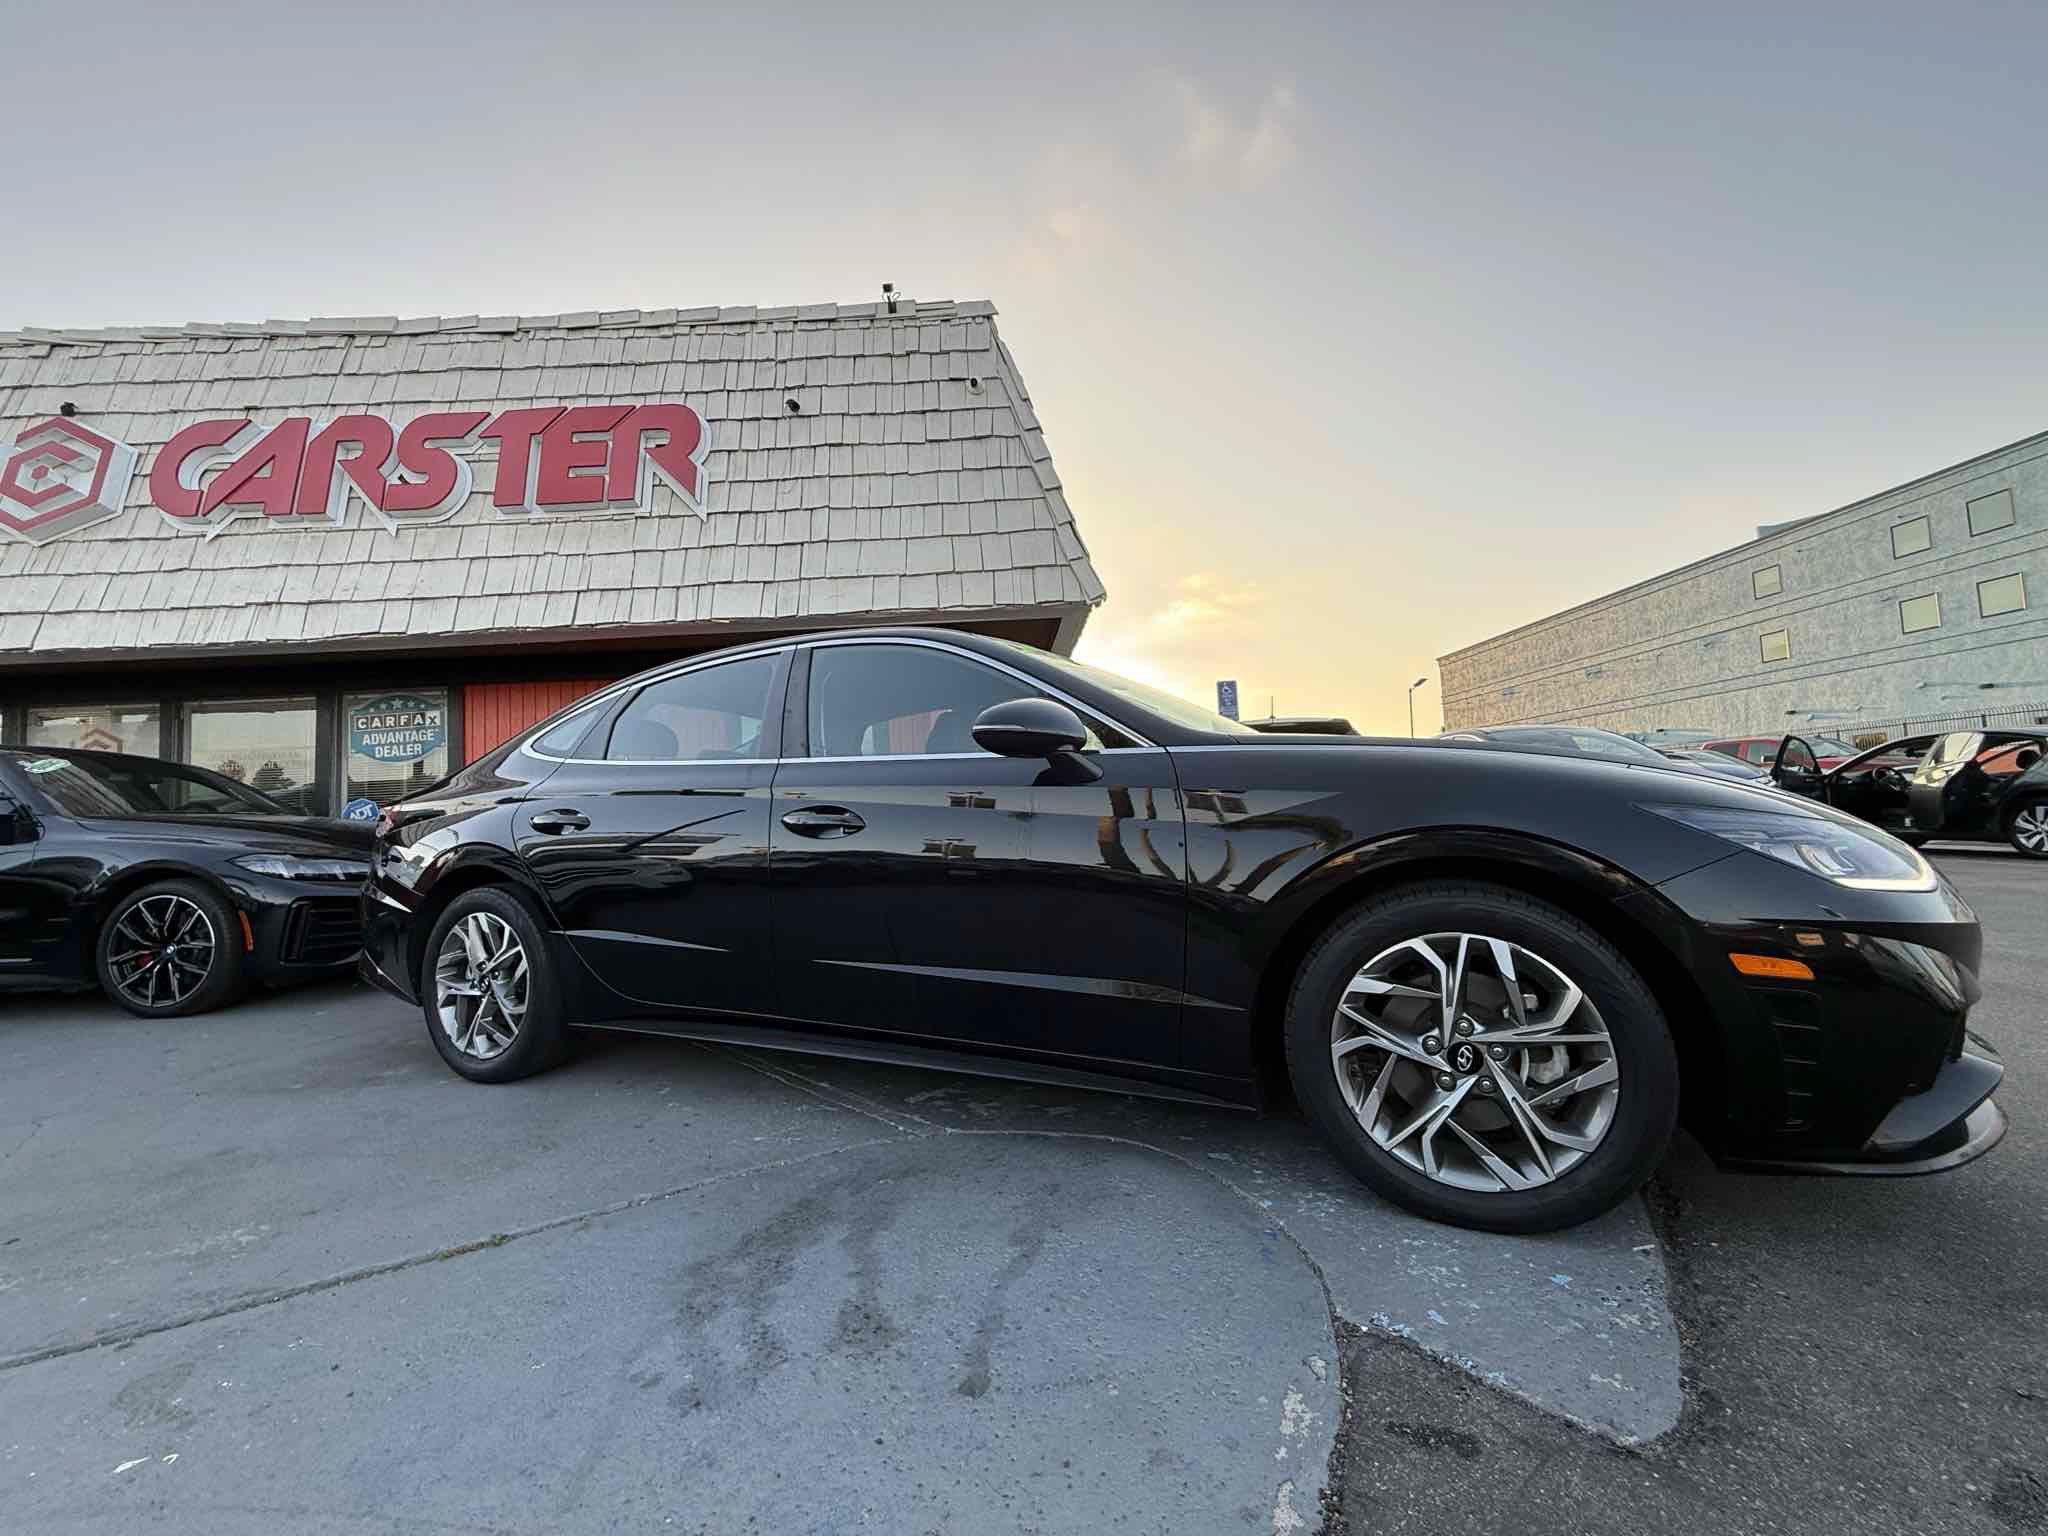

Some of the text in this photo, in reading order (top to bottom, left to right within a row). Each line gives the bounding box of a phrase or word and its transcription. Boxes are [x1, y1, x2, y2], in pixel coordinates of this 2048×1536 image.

[148, 403, 707, 523] CARSTER
[357, 712, 438, 729] CARFAX
[362, 729, 434, 745] ADVANTAGE
[375, 743, 422, 758] DEALER
[350, 804, 373, 820] ADT
